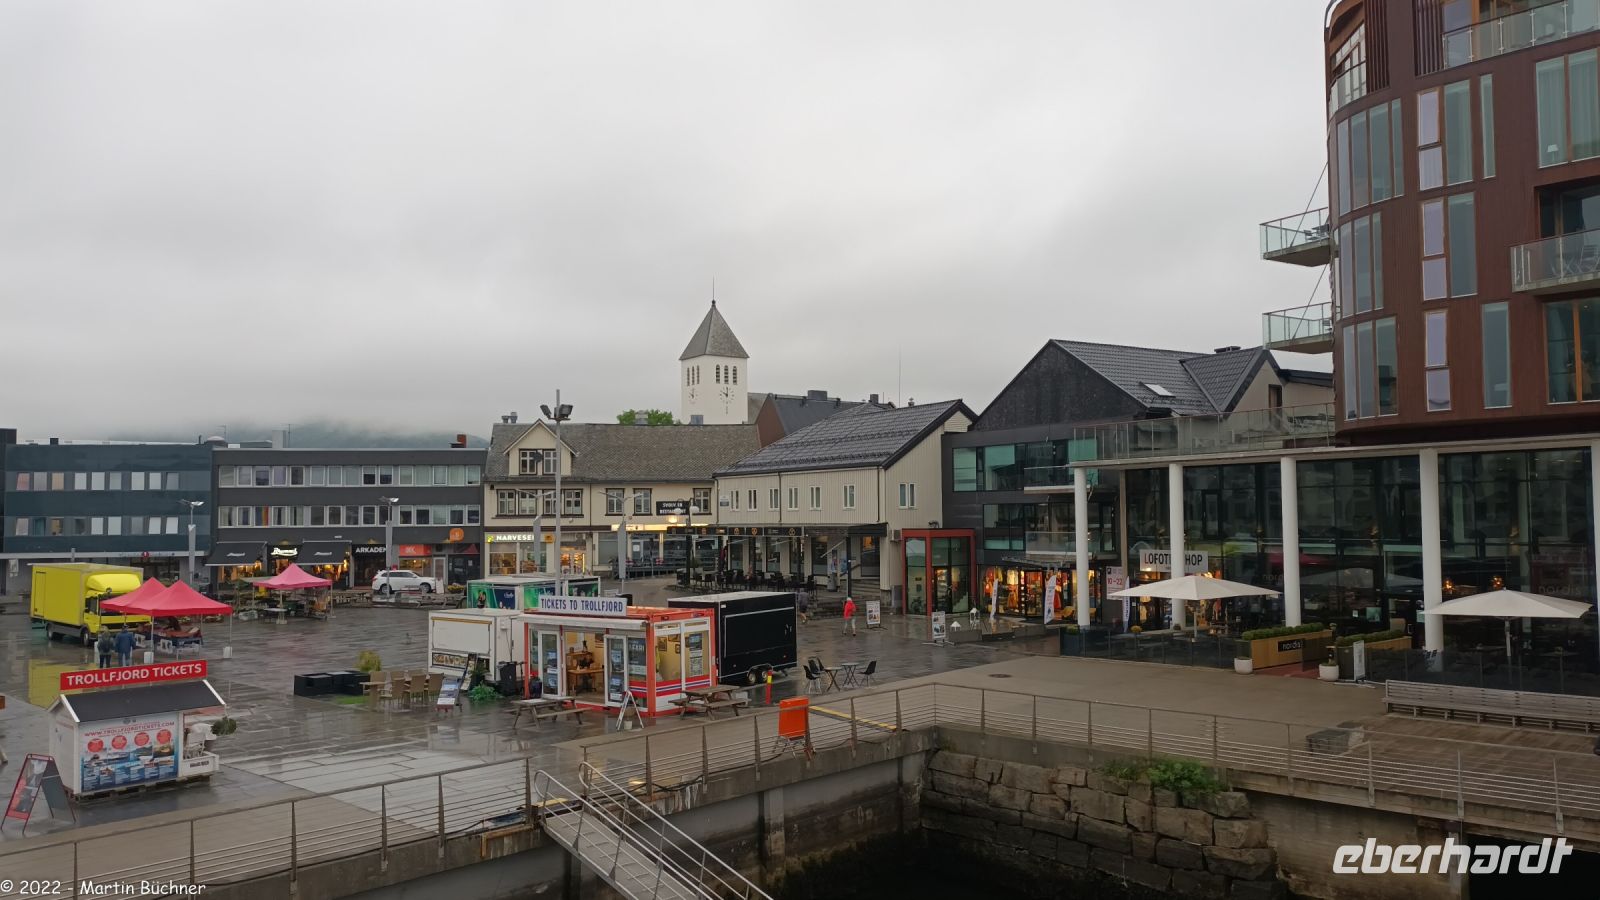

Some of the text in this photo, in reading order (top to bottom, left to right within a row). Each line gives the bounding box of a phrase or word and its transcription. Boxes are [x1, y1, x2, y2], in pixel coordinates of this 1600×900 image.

[1184, 554, 1203, 566] HOP
[541, 598, 623, 612] TICKETS TO TROLLFJORD
[66, 663, 202, 686] TROLLFJORD TICKETS
